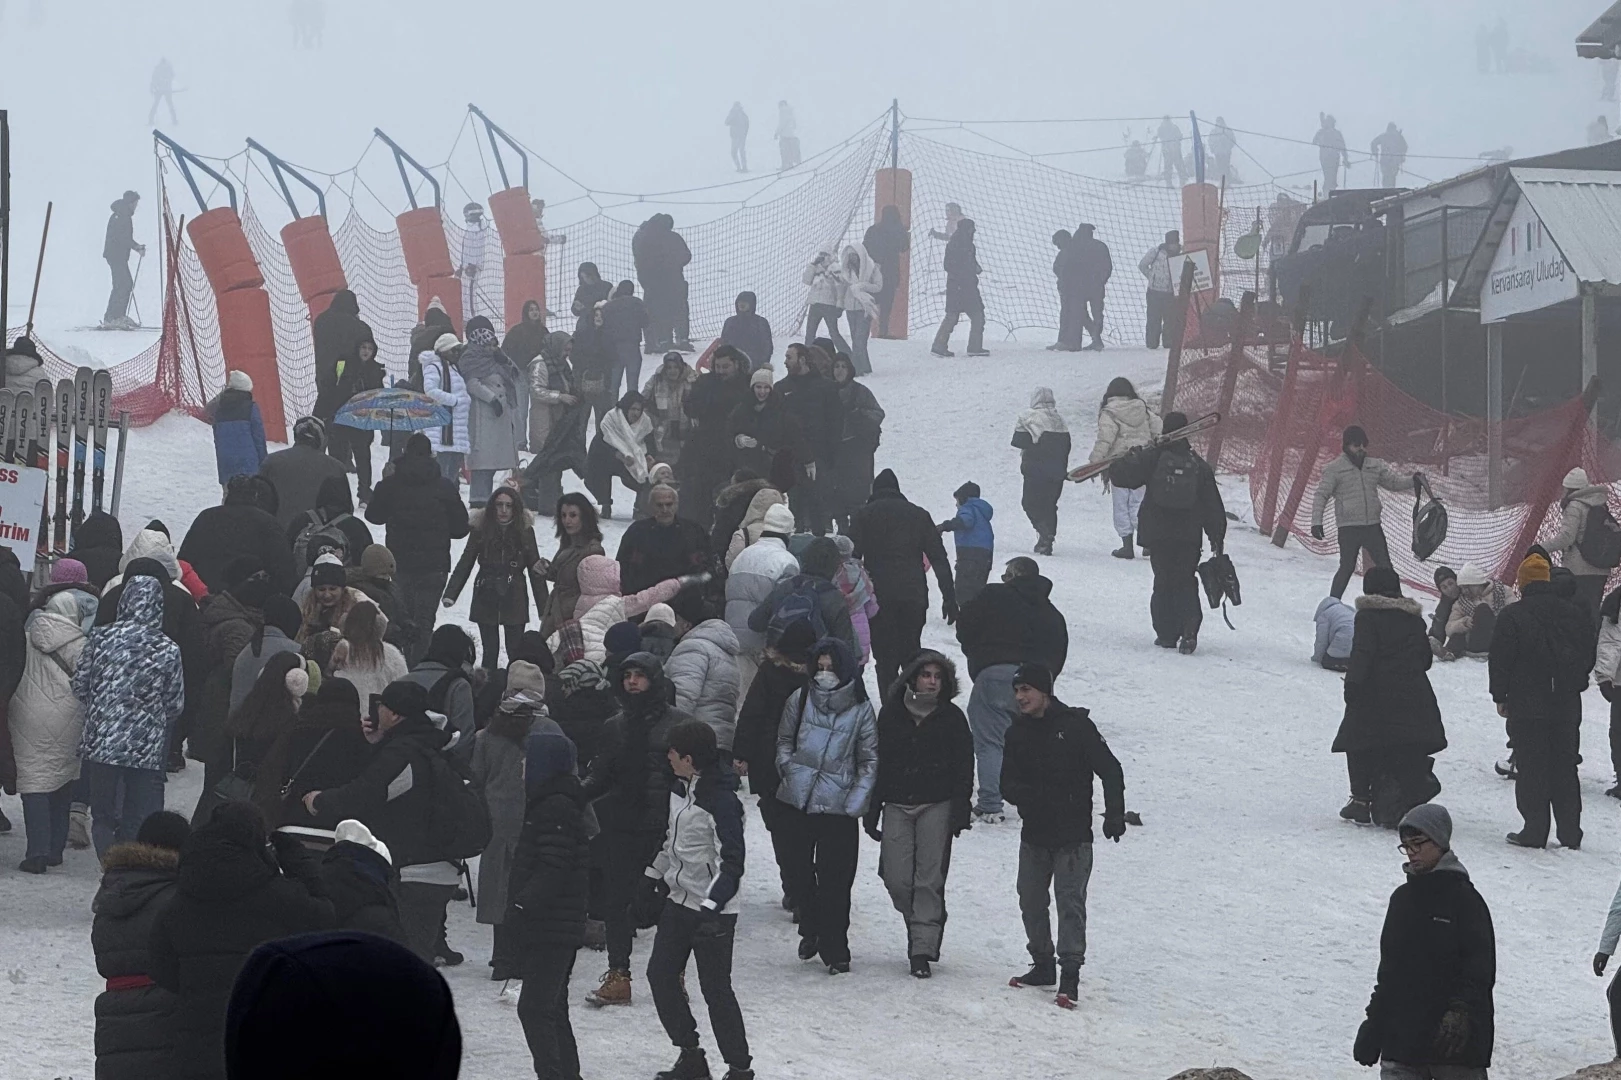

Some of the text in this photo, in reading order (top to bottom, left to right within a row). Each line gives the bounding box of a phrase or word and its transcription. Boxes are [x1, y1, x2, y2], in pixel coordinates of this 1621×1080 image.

[1491, 268, 1535, 295] kervansaray
[61, 393, 69, 434] HEAD
[79, 380, 88, 421] HEAD
[98, 387, 106, 429] HEAD
[18, 408, 28, 449] HEAD
